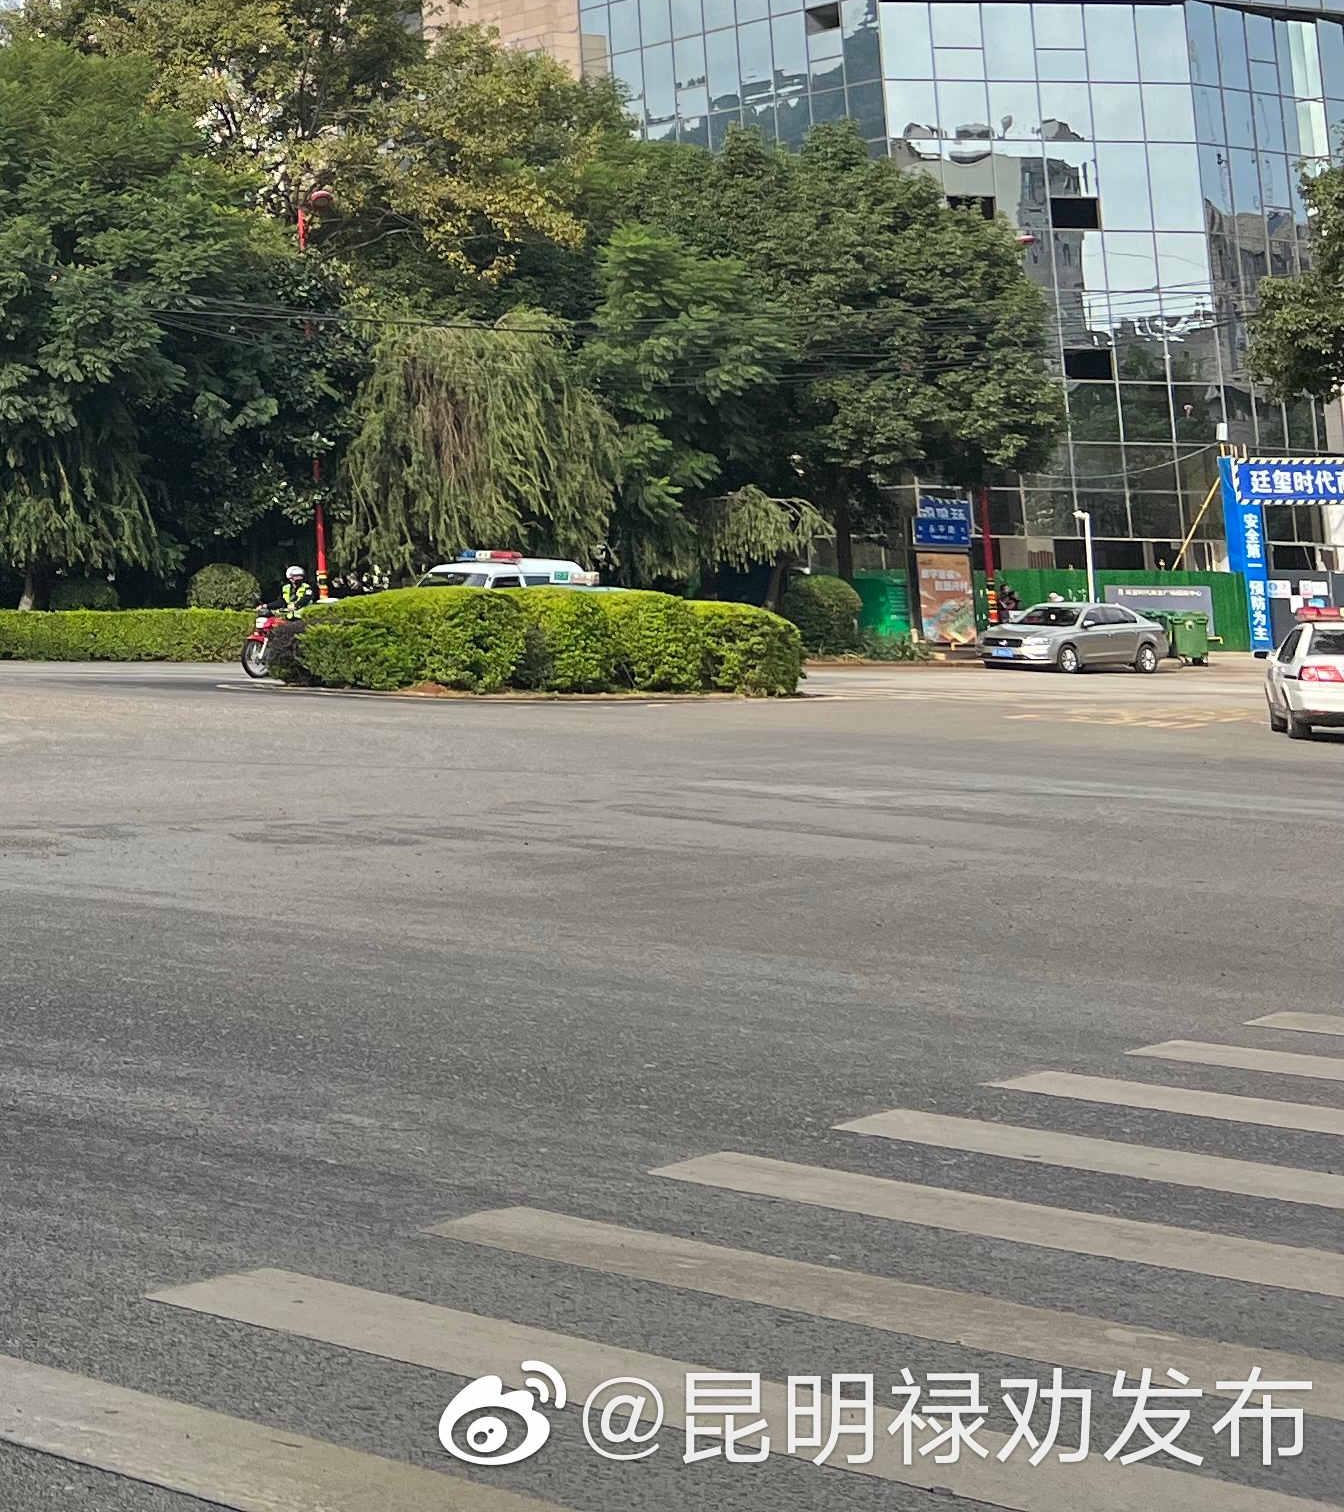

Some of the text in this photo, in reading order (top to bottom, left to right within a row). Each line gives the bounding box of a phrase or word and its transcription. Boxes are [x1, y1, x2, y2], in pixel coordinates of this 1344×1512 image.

[1243, 512, 1264, 569] 安全第一
[1249, 580, 1269, 641] 预防为主
